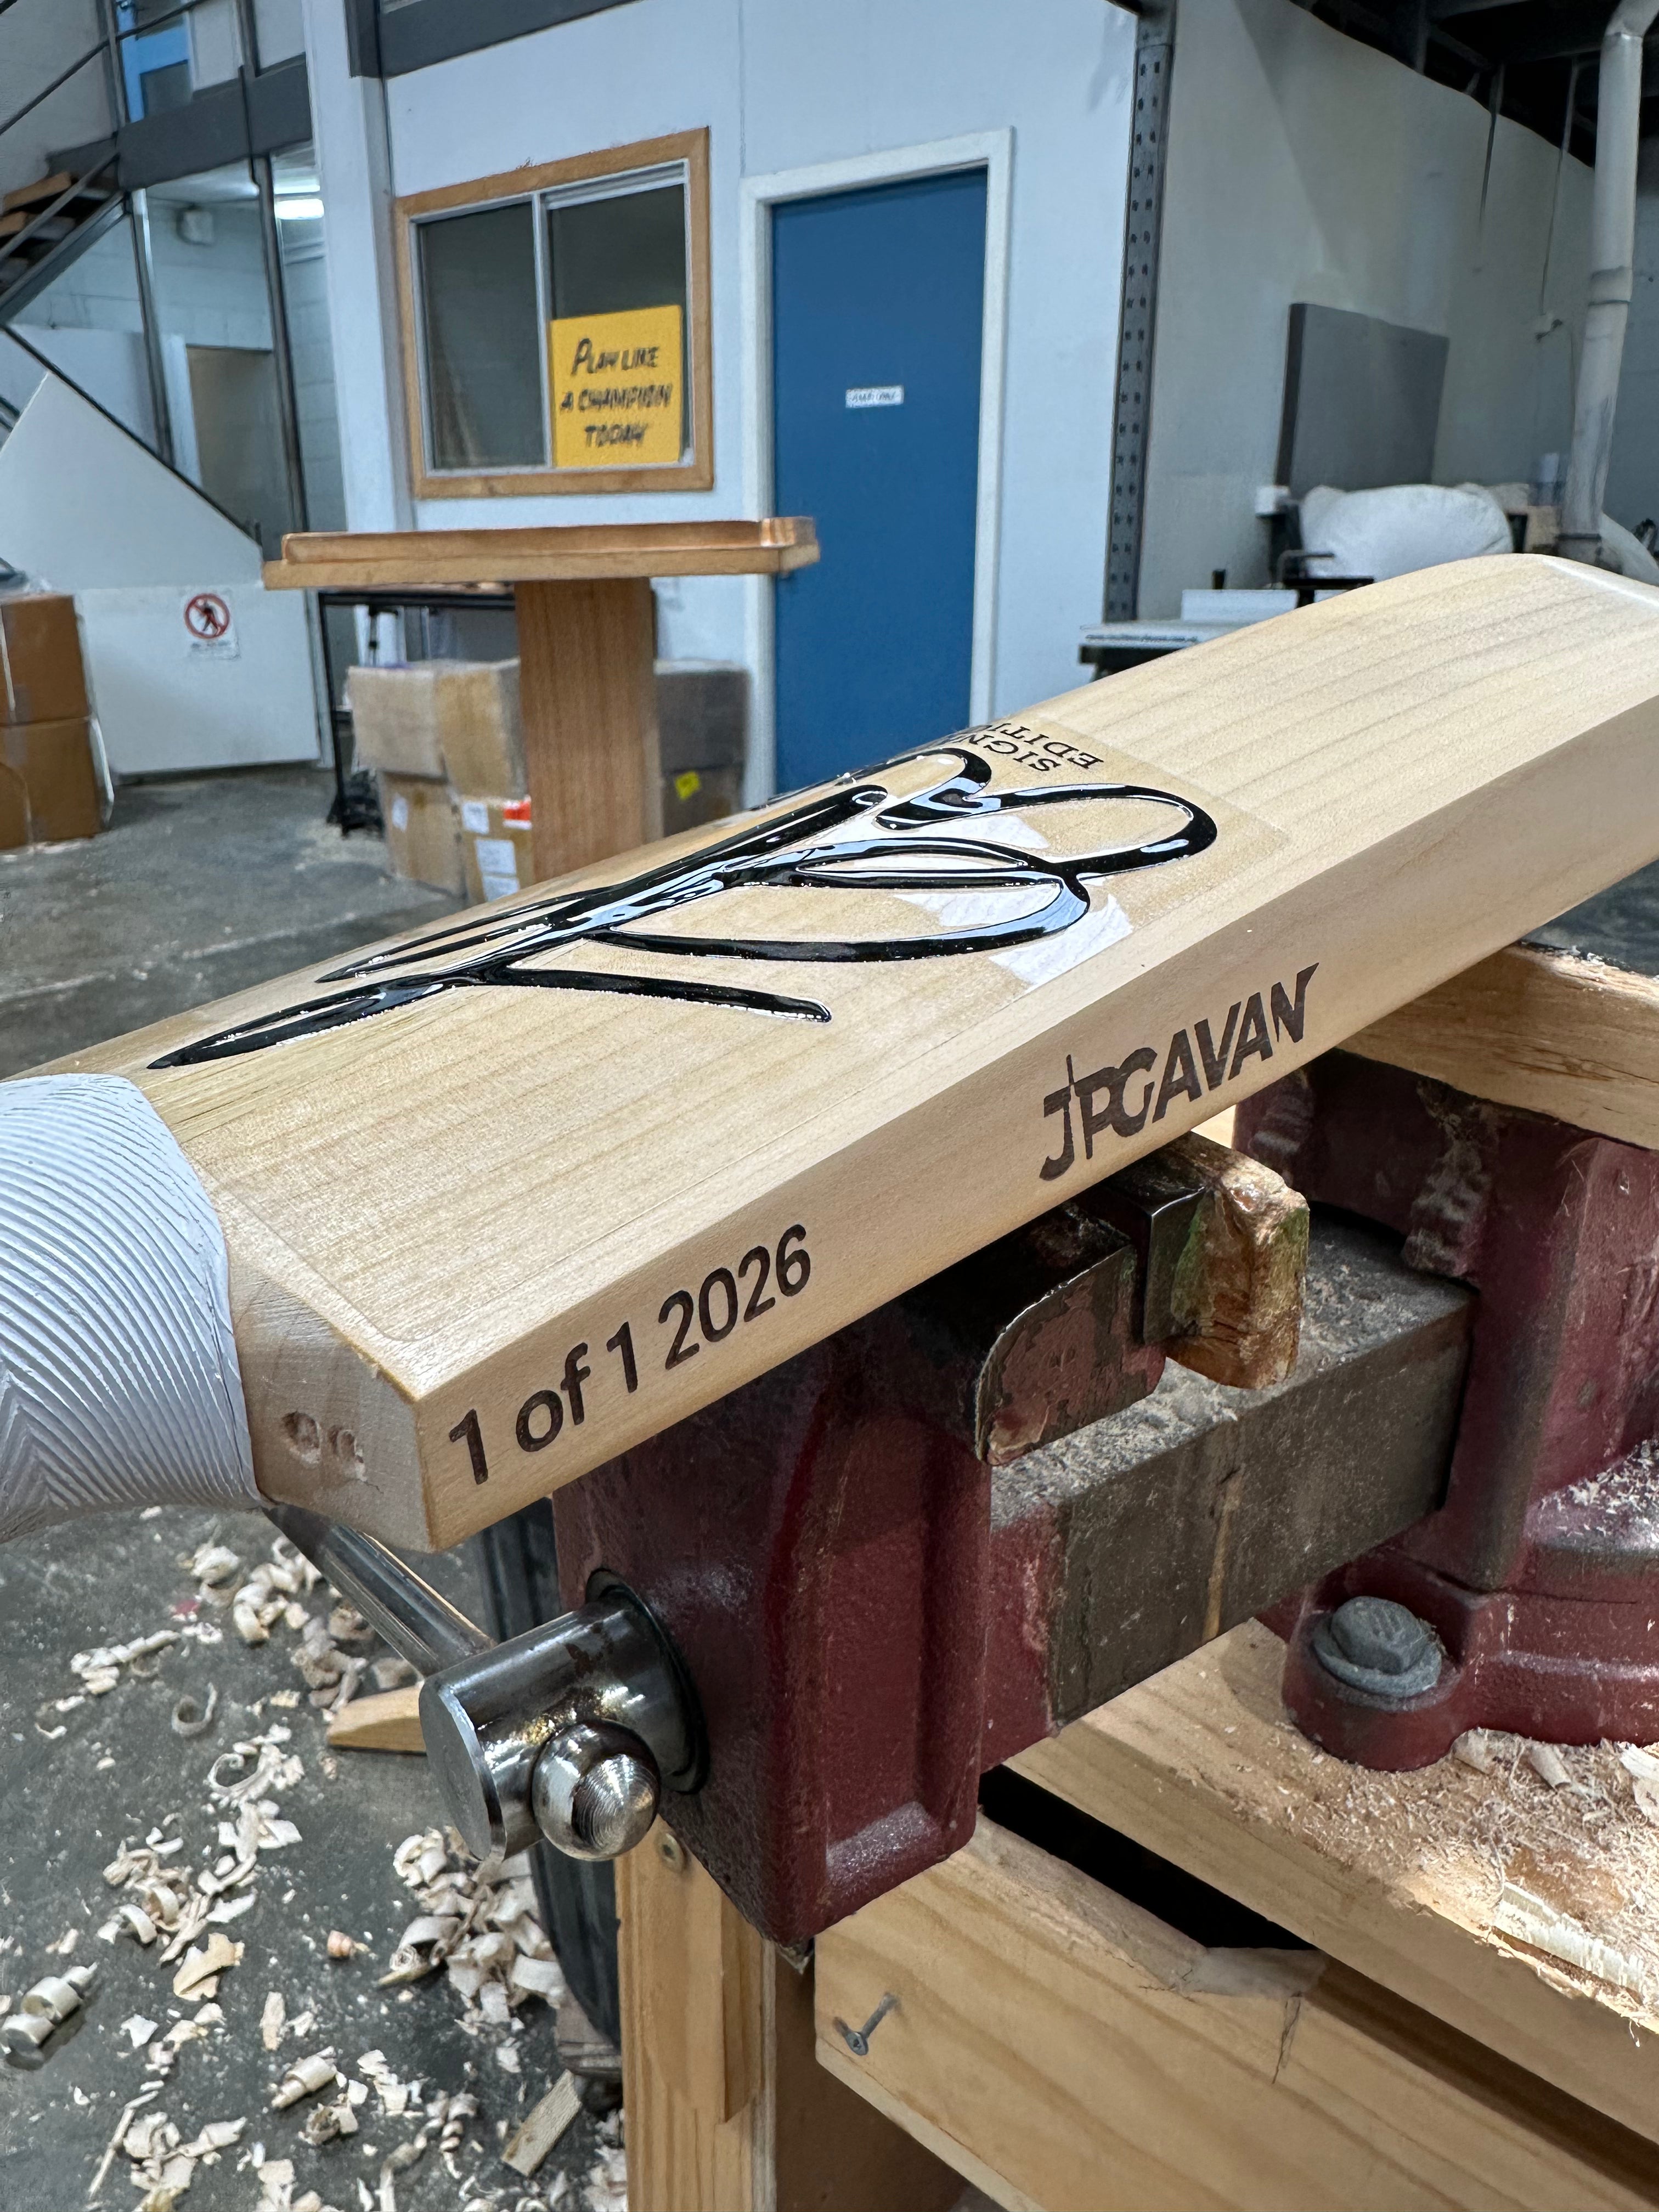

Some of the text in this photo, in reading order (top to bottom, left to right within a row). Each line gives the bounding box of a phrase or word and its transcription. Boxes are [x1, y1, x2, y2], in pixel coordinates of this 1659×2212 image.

[621, 346, 659, 371] LIKE
[560, 384, 673, 414] A CHAMPION
[584, 424, 649, 448] TODAY
[952, 734, 1060, 771] SIGN
[449, 1224, 811, 1485] 1 of 1 2026
